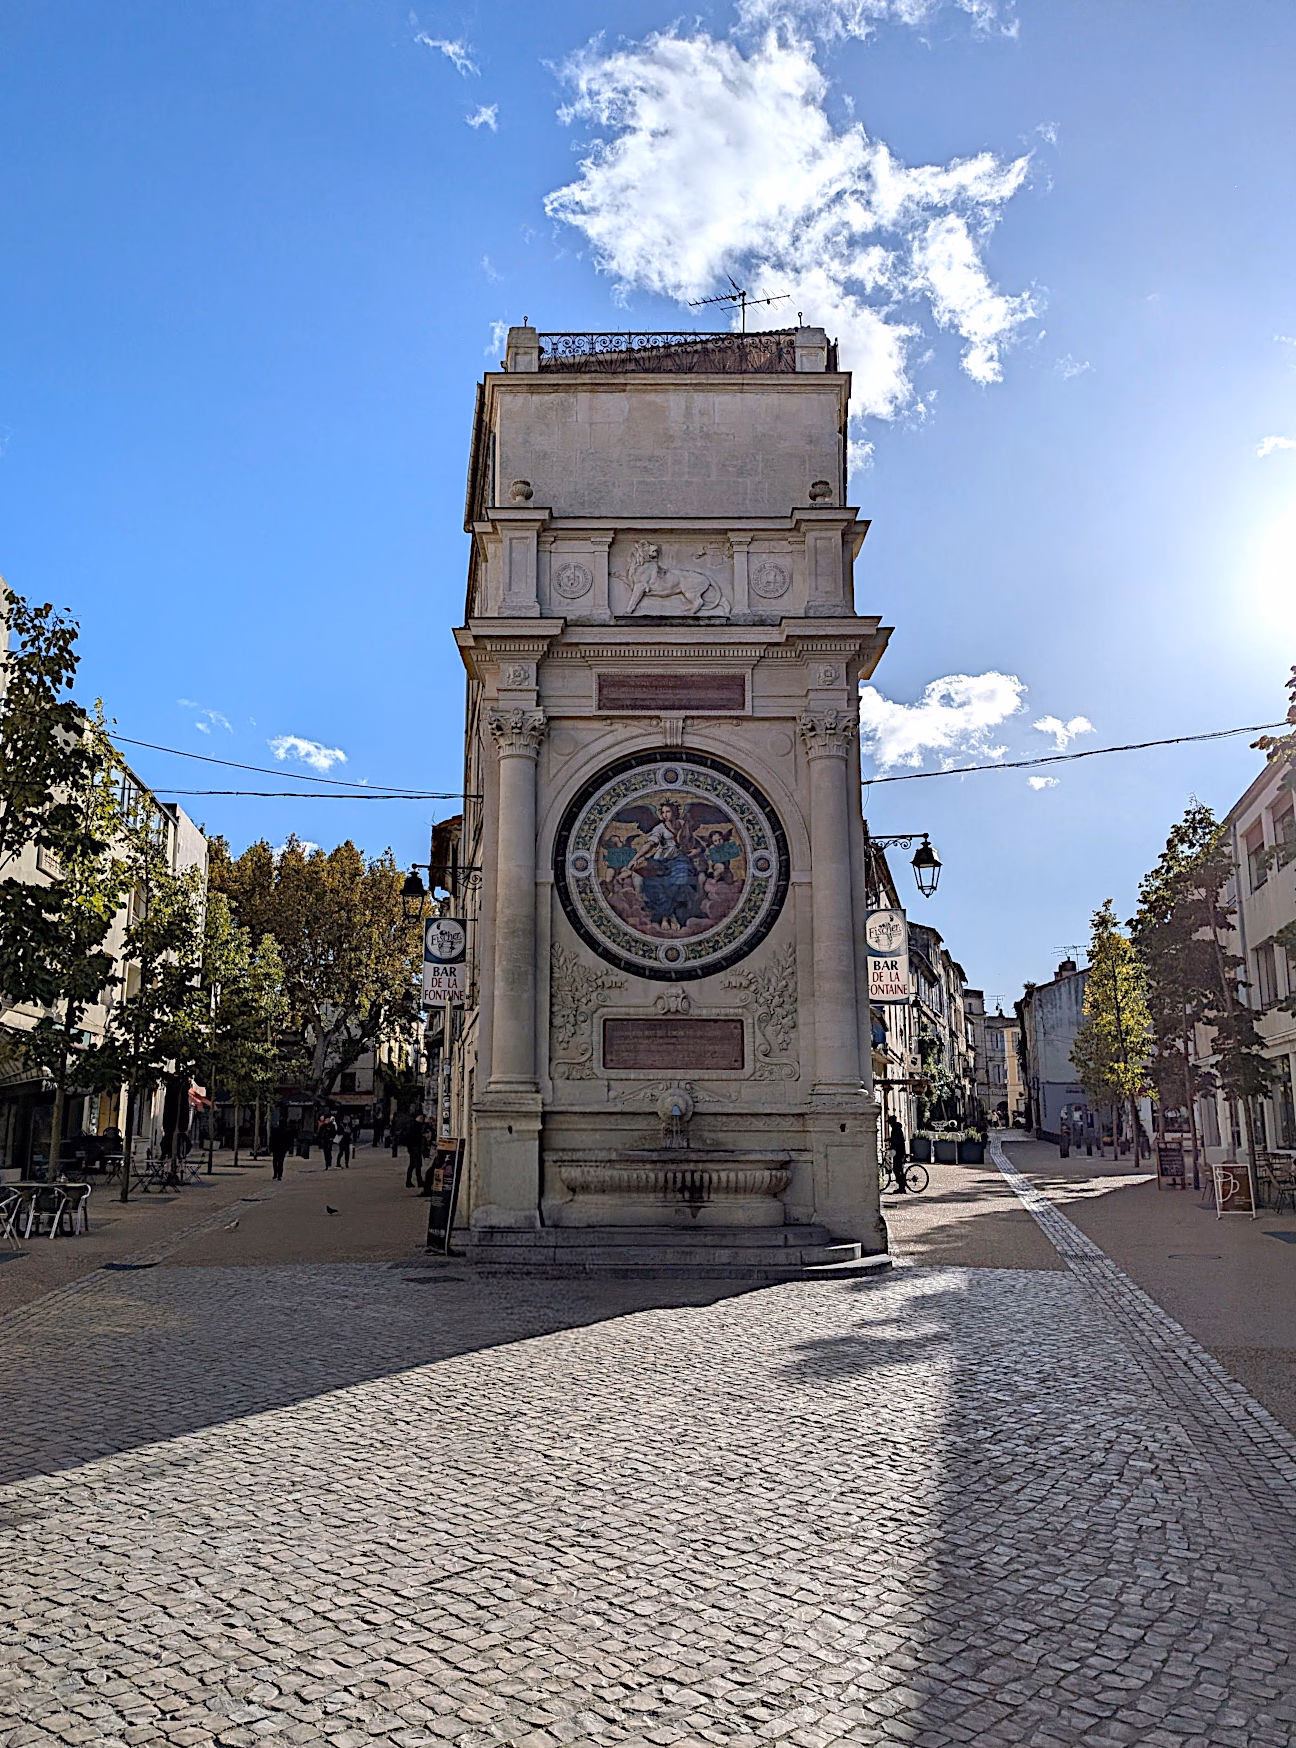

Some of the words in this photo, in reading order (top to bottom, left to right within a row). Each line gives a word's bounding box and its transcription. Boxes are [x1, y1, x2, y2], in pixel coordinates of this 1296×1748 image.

[873, 960, 899, 971] BAR
[433, 966, 457, 977] BAR
[872, 971, 884, 982] DE
[889, 971, 900, 982] LA
[431, 977, 443, 988] DE
[447, 977, 458, 988] LA
